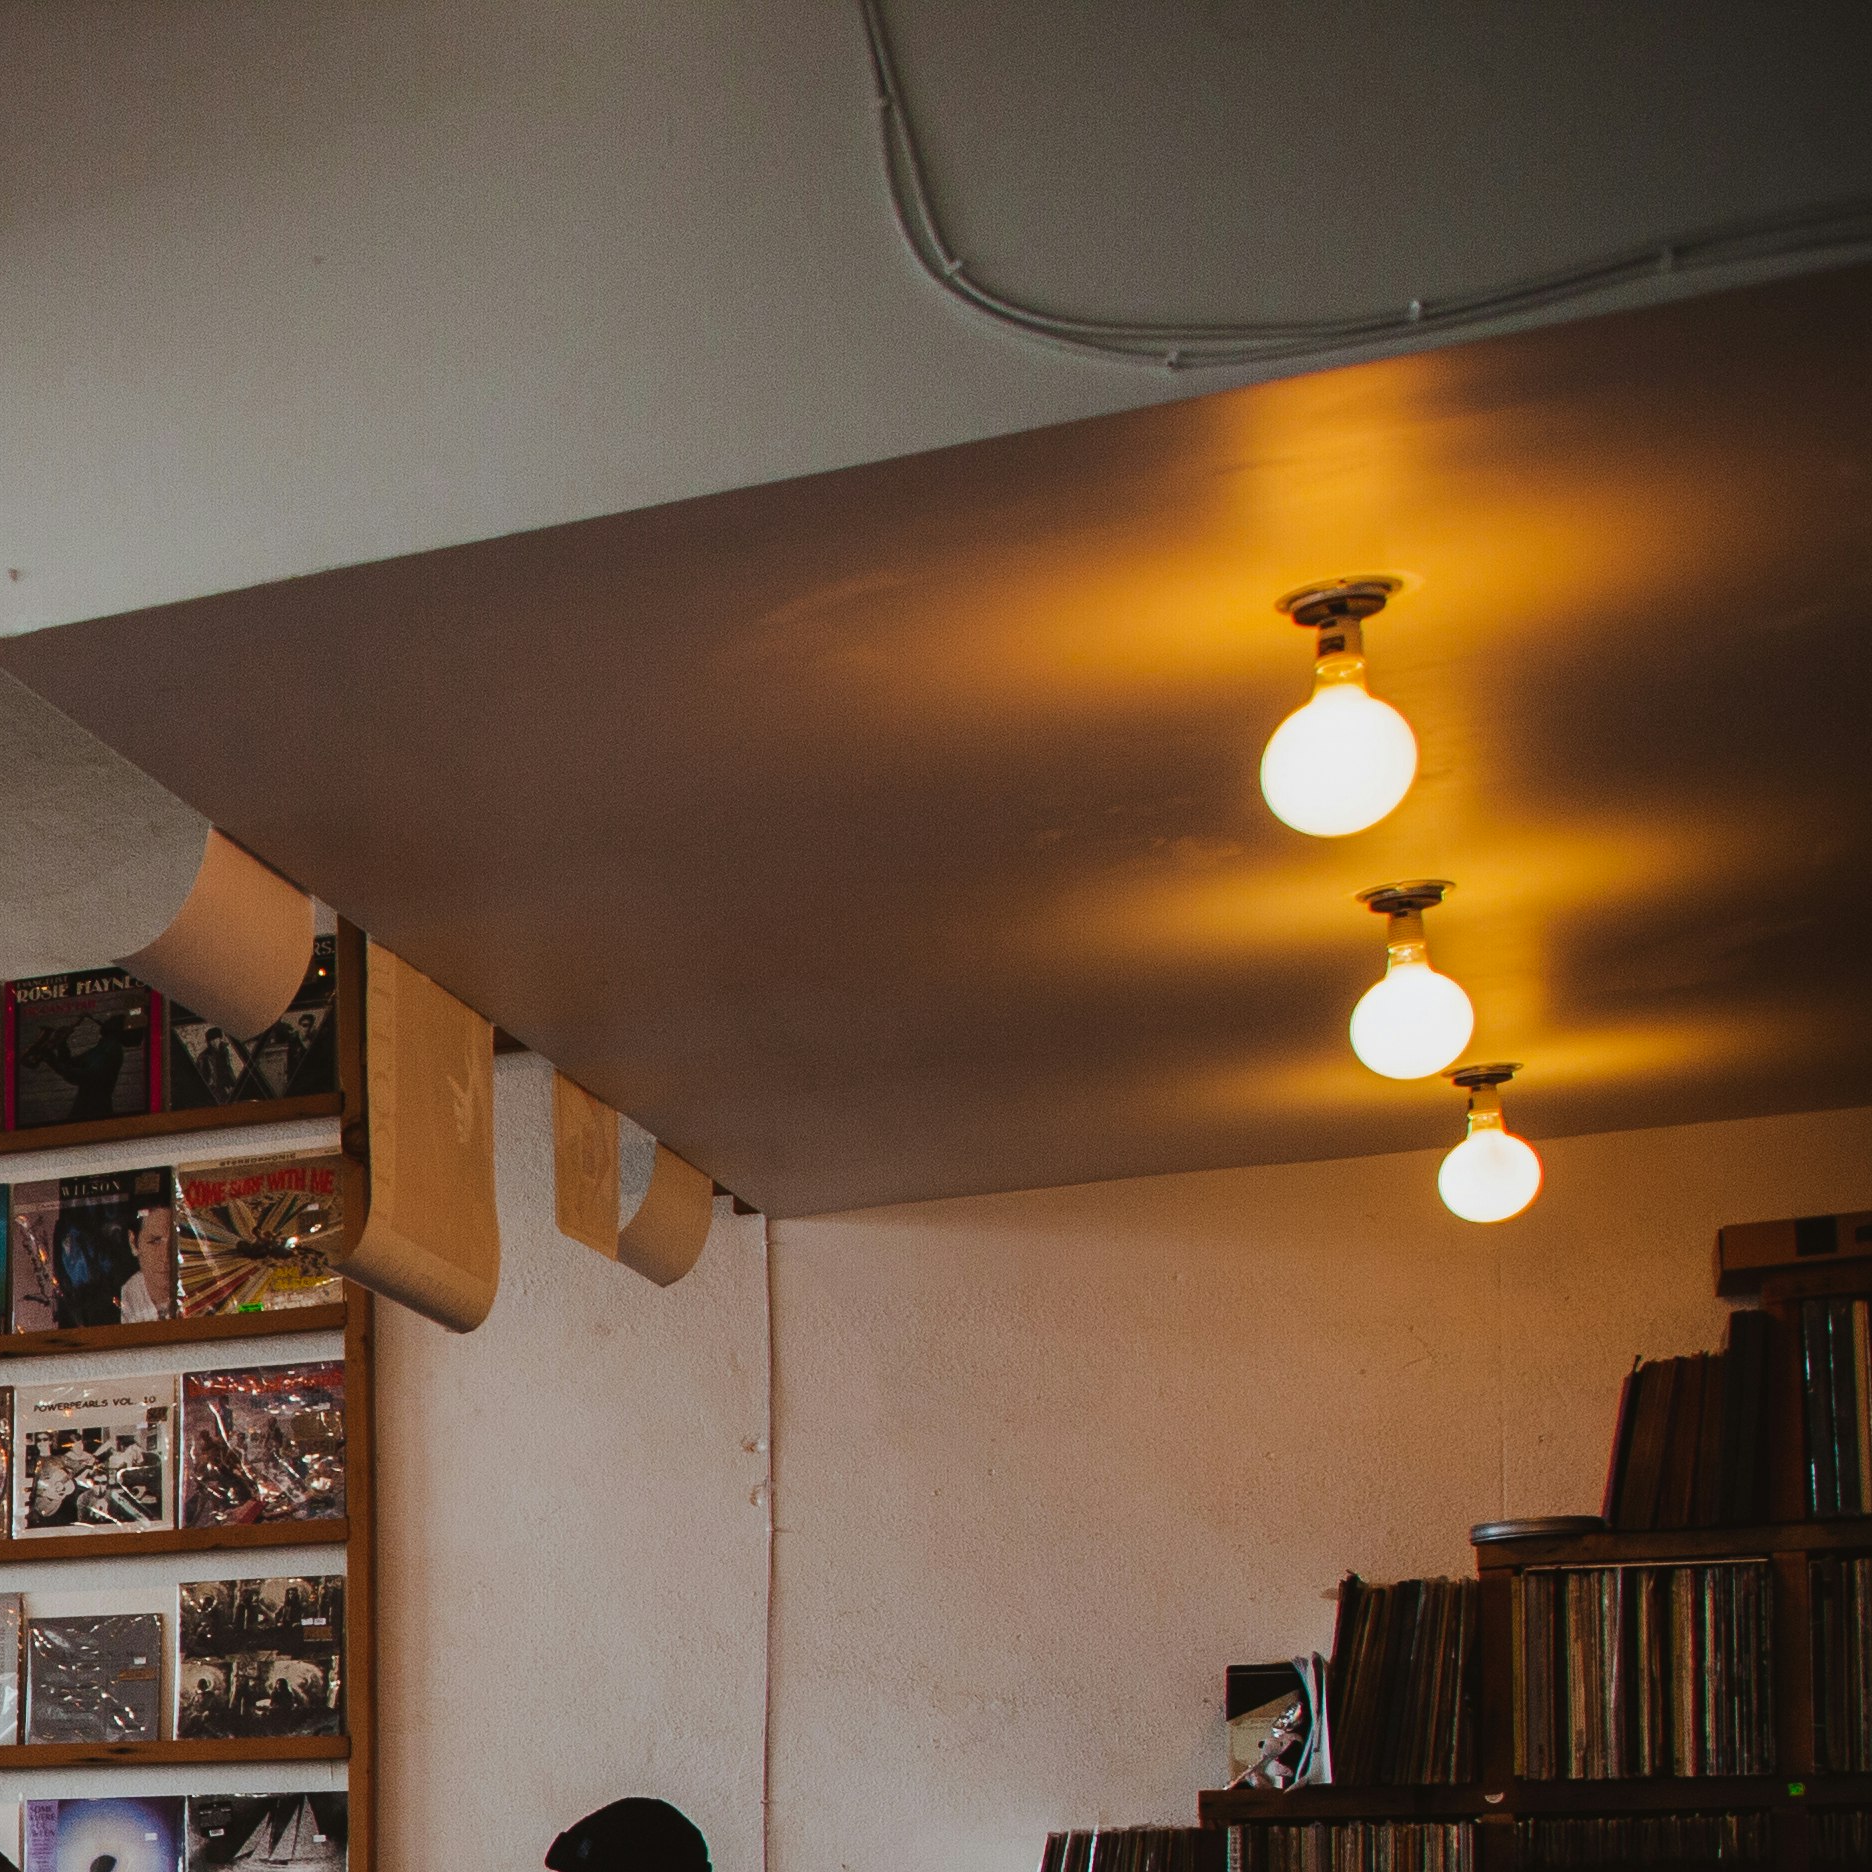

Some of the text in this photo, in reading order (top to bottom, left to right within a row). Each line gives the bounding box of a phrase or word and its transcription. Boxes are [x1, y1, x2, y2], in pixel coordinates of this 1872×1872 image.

[15, 983, 69, 1003] ROSIE
[60, 1179, 122, 1197] WILSON
[227, 1174, 263, 1196] SURF
[266, 1168, 307, 1192] WITH
[313, 1168, 335, 1194] ME
[33, 1400, 108, 1412] POWERPEARLS
[144, 1396, 157, 1405] 10
